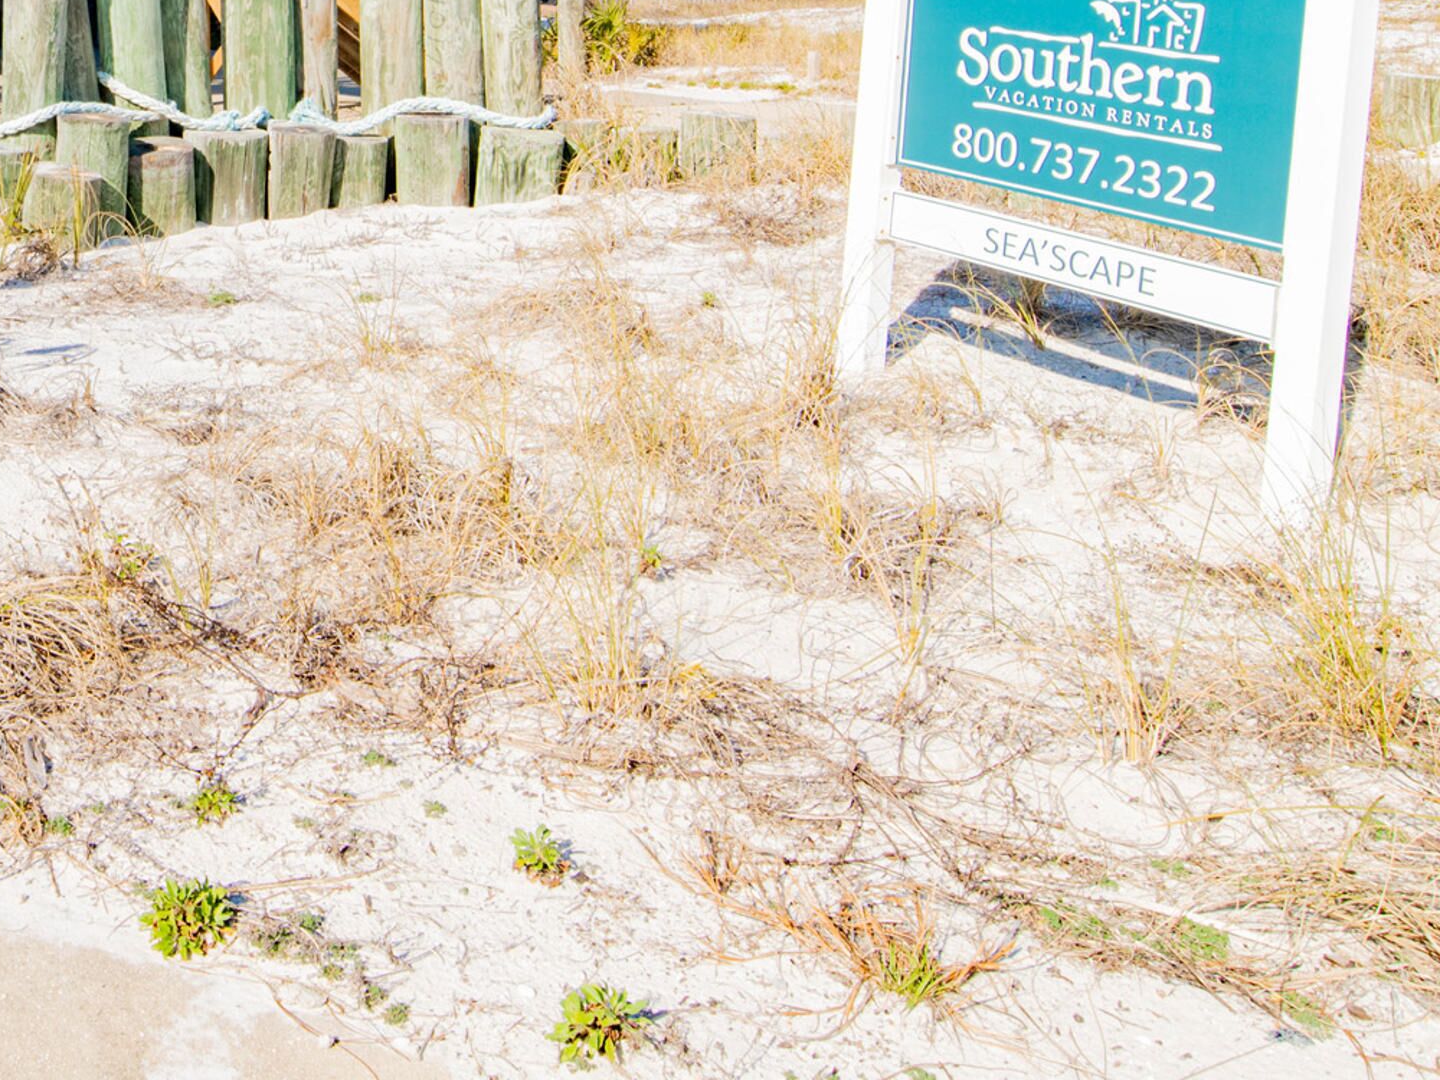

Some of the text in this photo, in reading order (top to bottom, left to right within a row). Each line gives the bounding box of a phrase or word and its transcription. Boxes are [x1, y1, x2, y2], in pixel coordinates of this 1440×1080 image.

[956, 26, 1215, 115] Southern
[984, 85, 1213, 140] VACATION RENTALS
[951, 123, 1216, 212] 800.737.2322
[982, 227, 1158, 297] SEA'SCAPE
